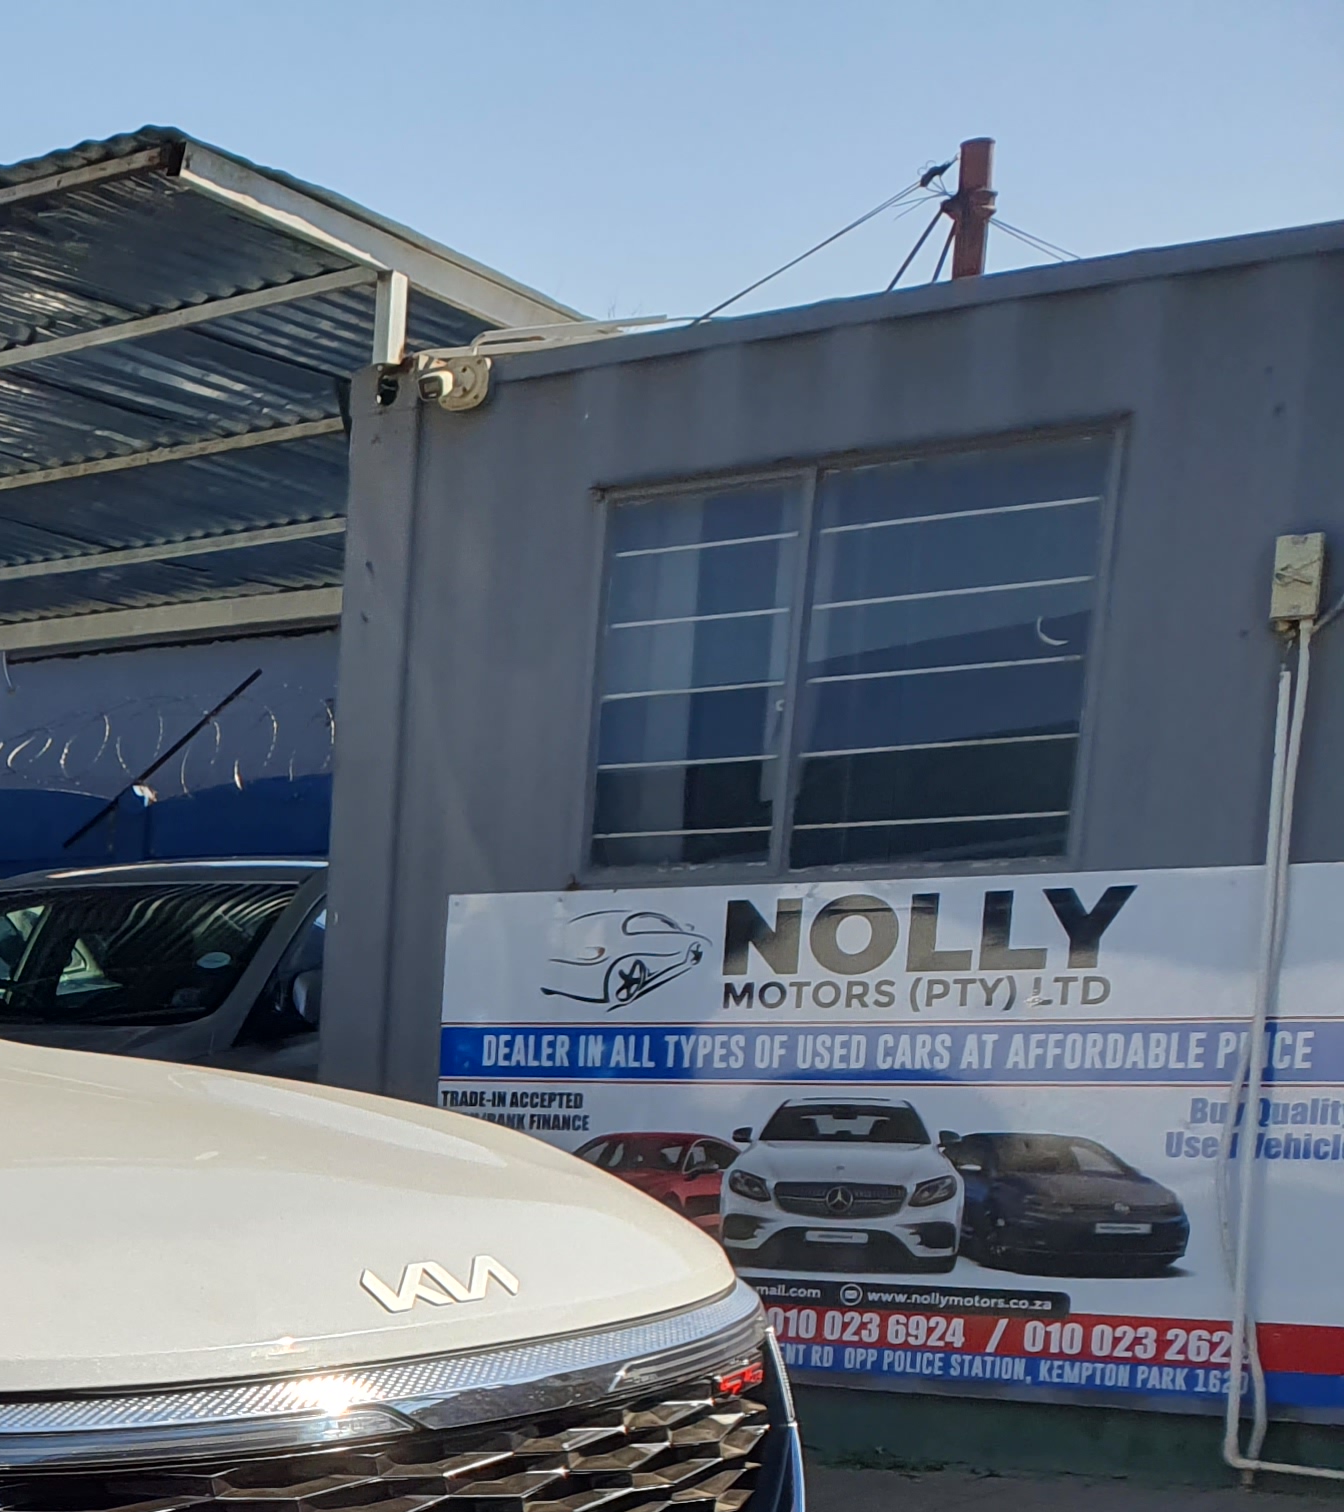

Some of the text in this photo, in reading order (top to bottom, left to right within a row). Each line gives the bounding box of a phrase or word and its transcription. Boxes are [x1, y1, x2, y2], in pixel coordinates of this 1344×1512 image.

[722, 885, 1138, 976] NOLLY
[722, 975, 1111, 1012] MOTORS (PTY) LTD
[482, 1034, 570, 1068] DEALER
[578, 1034, 605, 1068] IN
[609, 1034, 656, 1069] ALL
[664, 1034, 746, 1069] TYPES
[754, 1034, 789, 1069] OF
[797, 1033, 867, 1070] USED
[876, 1033, 952, 1070] CARS
[959, 1033, 999, 1070] AT
[1005, 1031, 1208, 1070] AFFORDABLE
[440, 1090, 584, 1109] TRADE-IN ACCEPTED
[1256, 1097, 1344, 1128] Qualit
[529, 1113, 590, 1131] FINANCE
[867, 1290, 1052, 1310] www.nollymotors.co.za
[767, 1306, 817, 1339] 010
[823, 1310, 880, 1343] 023
[887, 1314, 965, 1348] 6924
[1023, 1320, 1084, 1355] 010
[1091, 1324, 1158, 1359] 023
[1164, 1328, 1250, 1364] 262
[811, 1344, 834, 1367] RD
[844, 1346, 878, 1370] OPP
[882, 1348, 944, 1375] POLICE
[949, 1353, 1032, 1384] STATION,
[1039, 1359, 1130, 1388] KEMPTON
[1136, 1367, 1189, 1392] PARK
